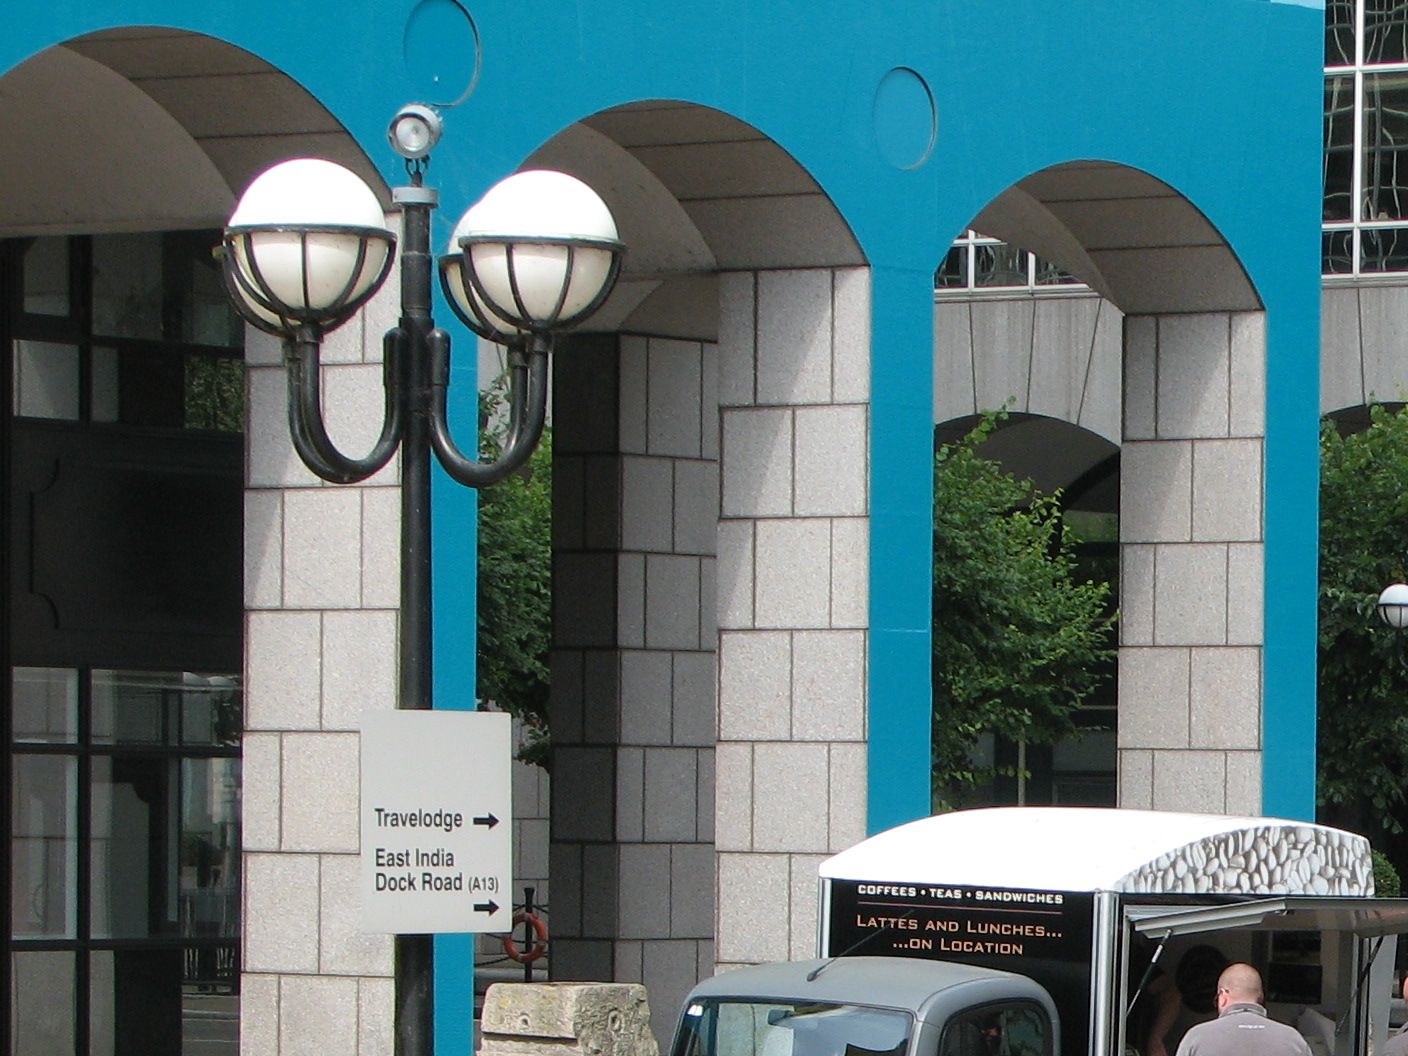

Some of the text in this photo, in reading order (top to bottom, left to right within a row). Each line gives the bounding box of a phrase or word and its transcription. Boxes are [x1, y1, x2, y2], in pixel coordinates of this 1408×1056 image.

[374, 808, 463, 832] Travelodge
[375, 848, 455, 867] East India
[375, 872, 499, 893] Dock Road (A13)
[858, 884, 1064, 905] COFFEES TEAS SANDWICHES
[856, 914, 918, 930] LATTES
[925, 920, 960, 932] AND
[940, 938, 1024, 955] LOCATION
